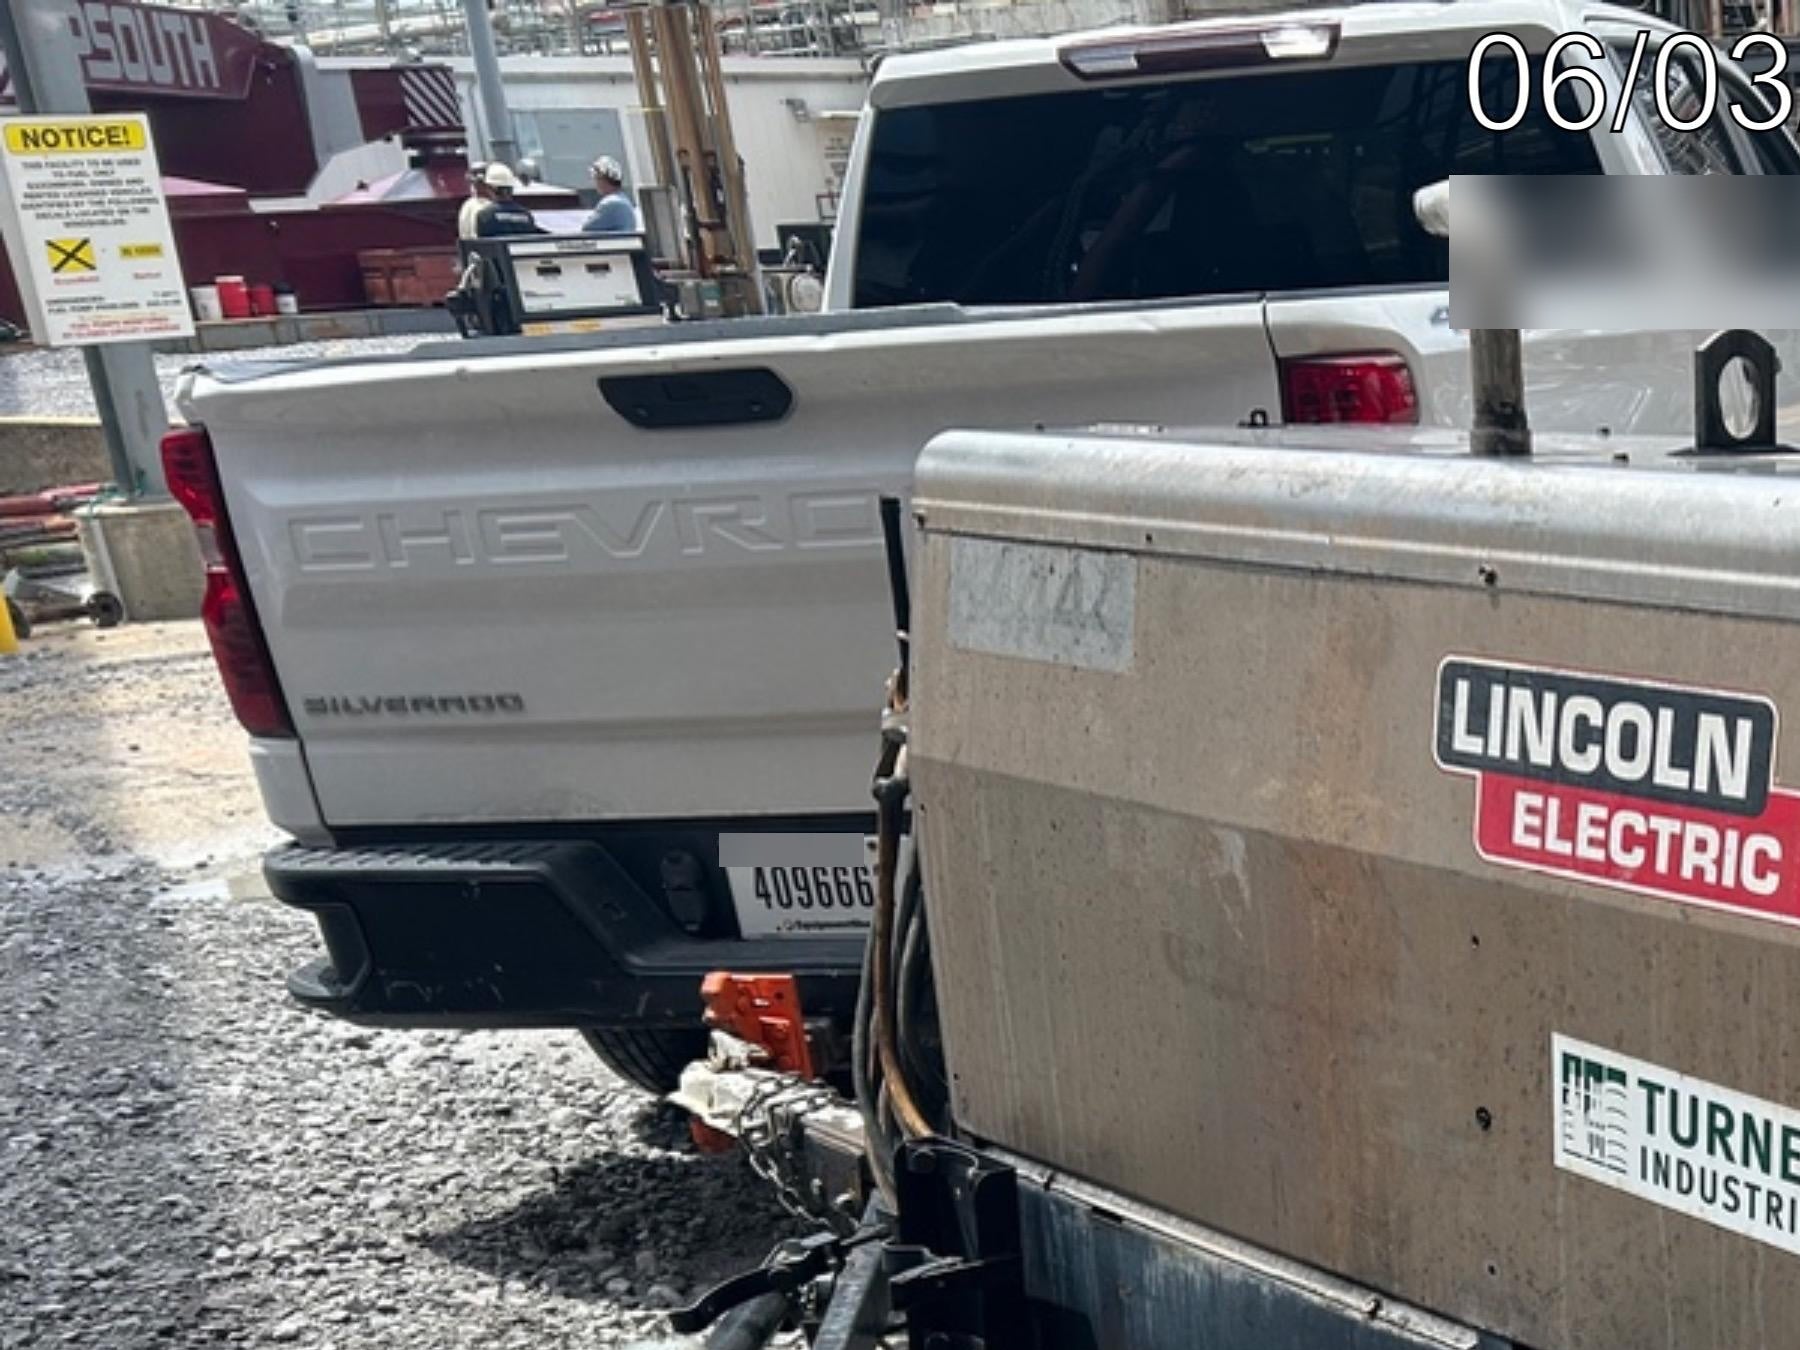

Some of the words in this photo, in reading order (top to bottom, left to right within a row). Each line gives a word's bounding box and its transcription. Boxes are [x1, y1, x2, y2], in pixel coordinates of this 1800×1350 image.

[20, 126, 131, 148] NOTICE!
[304, 692, 525, 718] SILVERADO
[1452, 679, 1753, 800] LINCOLN
[1511, 791, 1783, 897] ELECTRIC
[753, 866, 880, 910] 409666
